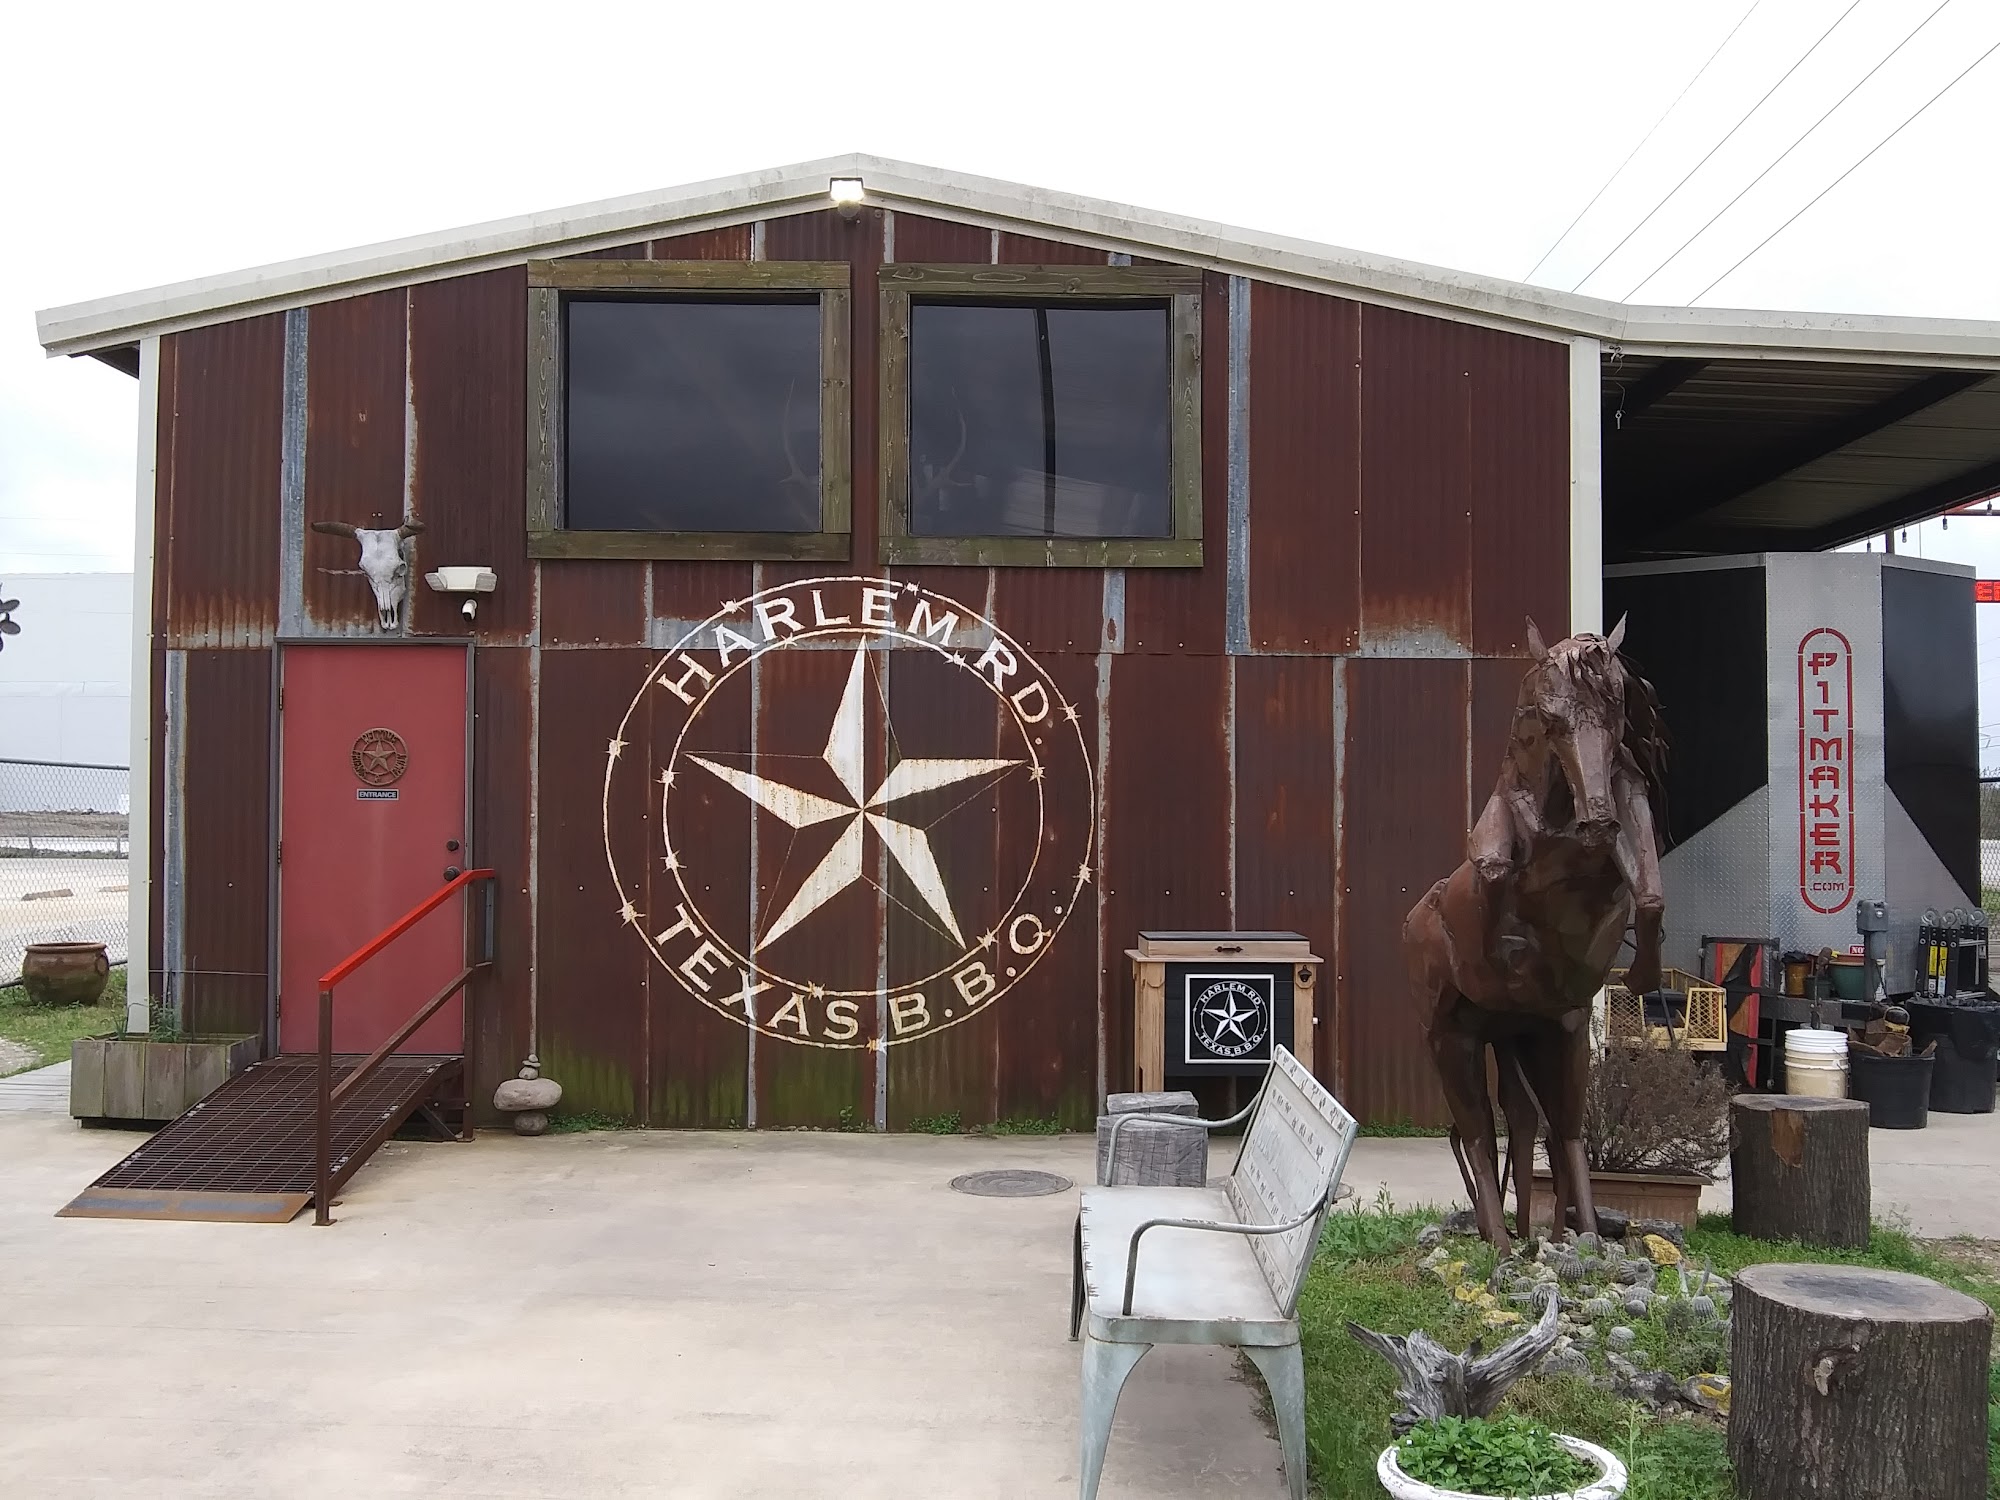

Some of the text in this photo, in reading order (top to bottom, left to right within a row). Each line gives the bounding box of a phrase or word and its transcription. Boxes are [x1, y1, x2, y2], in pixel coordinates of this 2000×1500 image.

[656, 587, 1050, 745] HARLEM RD.
[1807, 652, 1843, 875] PITMAKER
[654, 903, 1063, 1041] TEXAS B.B.Q.
[1200, 983, 1261, 1009] HARLEM RD.
[1200, 1032, 1263, 1055] TEXAS B.B.Q.
